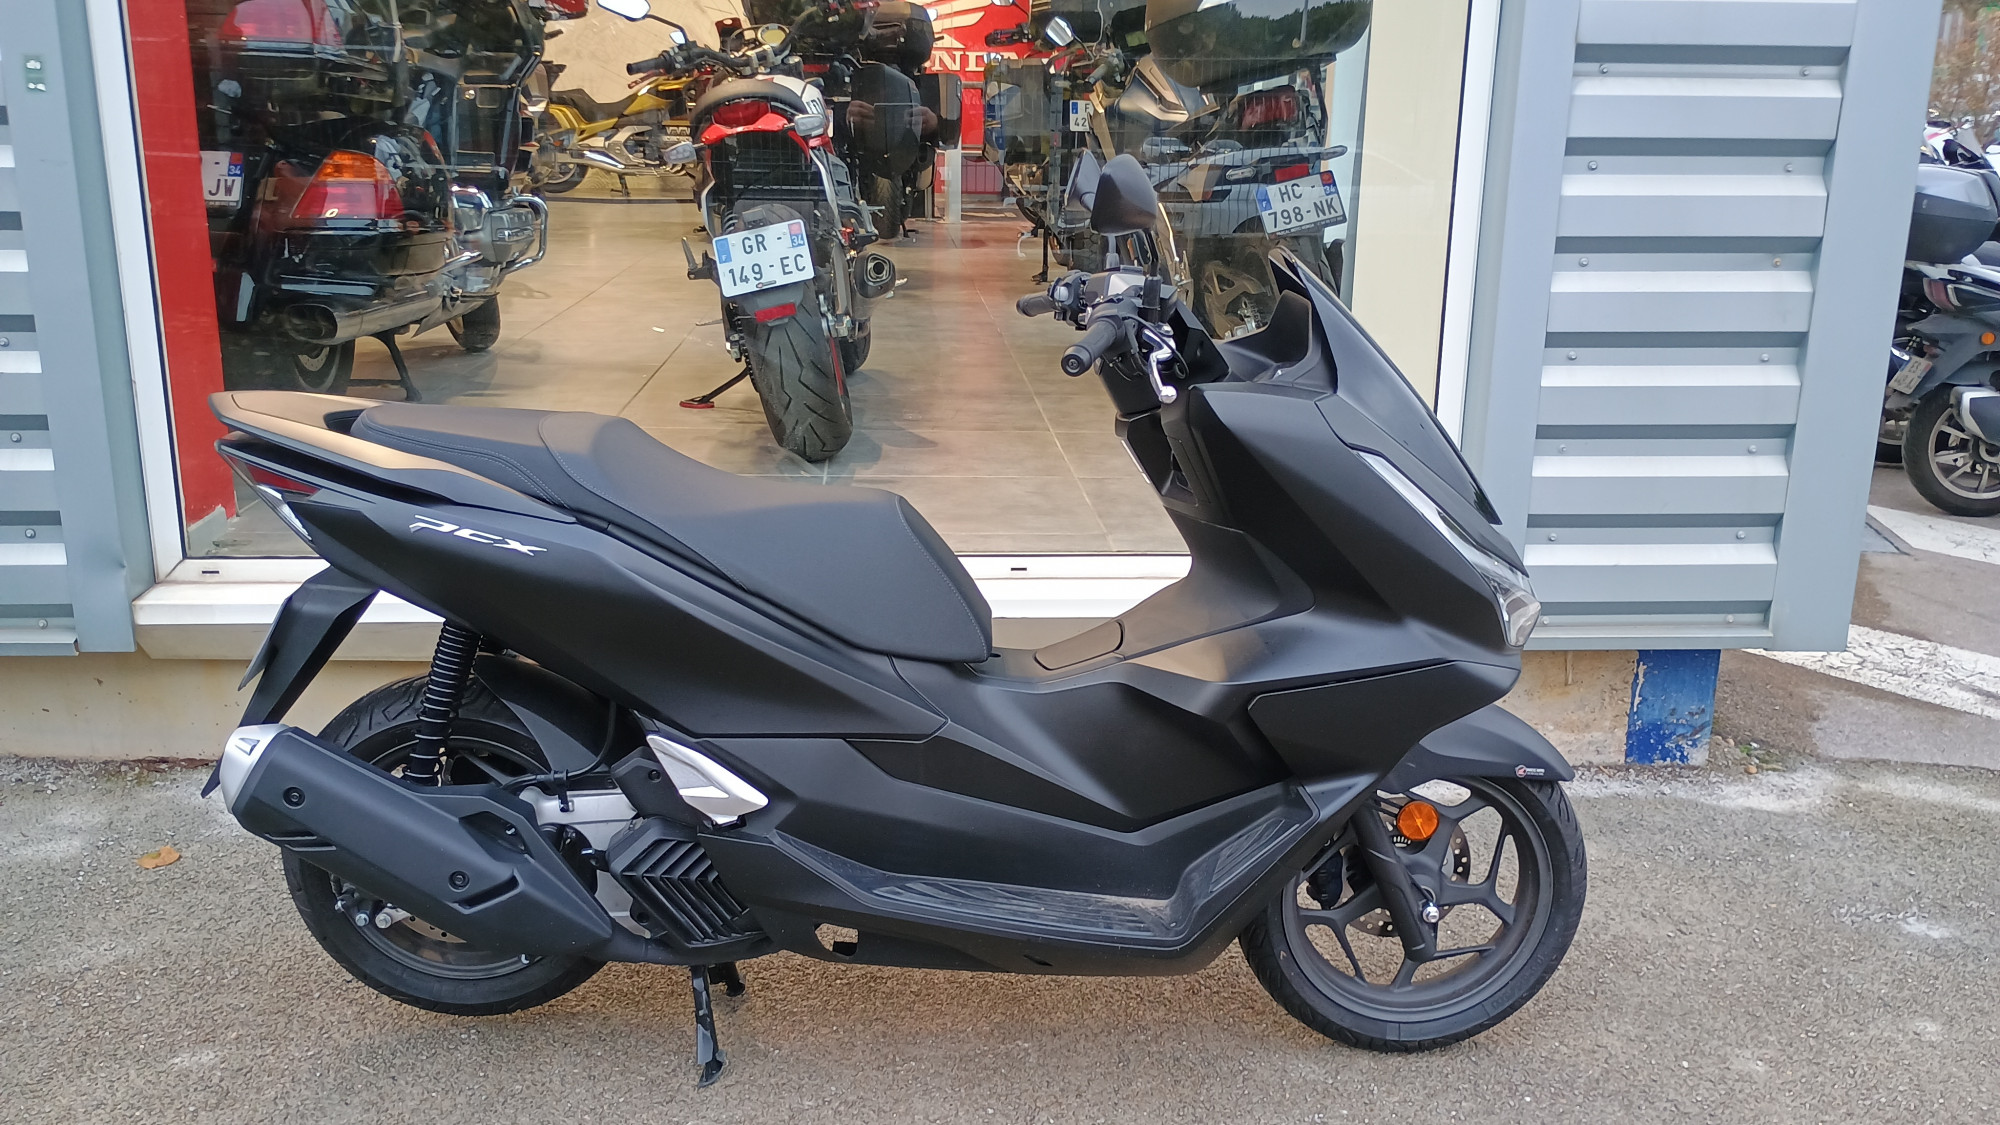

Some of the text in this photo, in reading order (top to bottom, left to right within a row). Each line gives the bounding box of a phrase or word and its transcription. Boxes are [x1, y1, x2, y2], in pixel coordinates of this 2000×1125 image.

[228, 165, 241, 175] 34
[208, 178, 236, 197] JW
[1323, 185, 1337, 195] 34
[791, 234, 804, 247] 34
[409, 514, 548, 557] PCX
